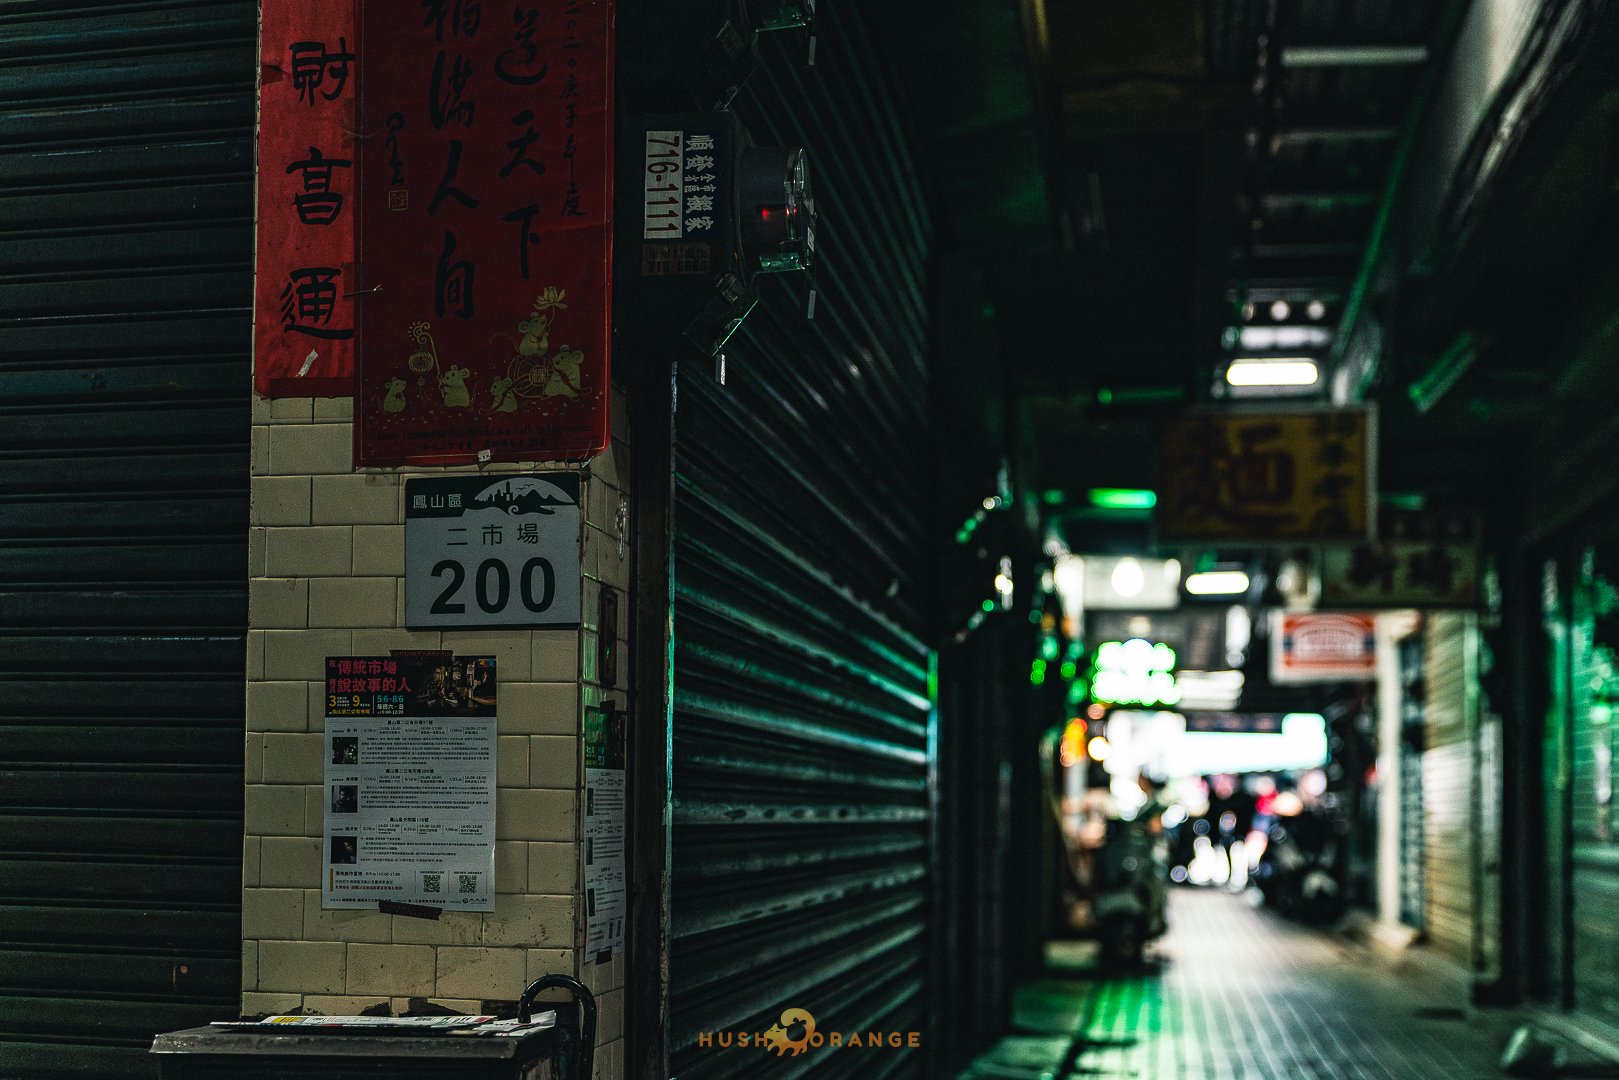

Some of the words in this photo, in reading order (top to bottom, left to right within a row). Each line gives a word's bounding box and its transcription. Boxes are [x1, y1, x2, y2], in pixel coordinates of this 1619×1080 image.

[646, 135, 680, 232] 716-1111
[413, 493, 462, 509] 鳳山區
[446, 523, 539, 546] 二市場
[429, 556, 556, 615] 200
[338, 659, 397, 675] 傳統市場
[337, 677, 412, 693] 說故事的人
[329, 695, 337, 707] 3
[352, 695, 360, 707] 9
